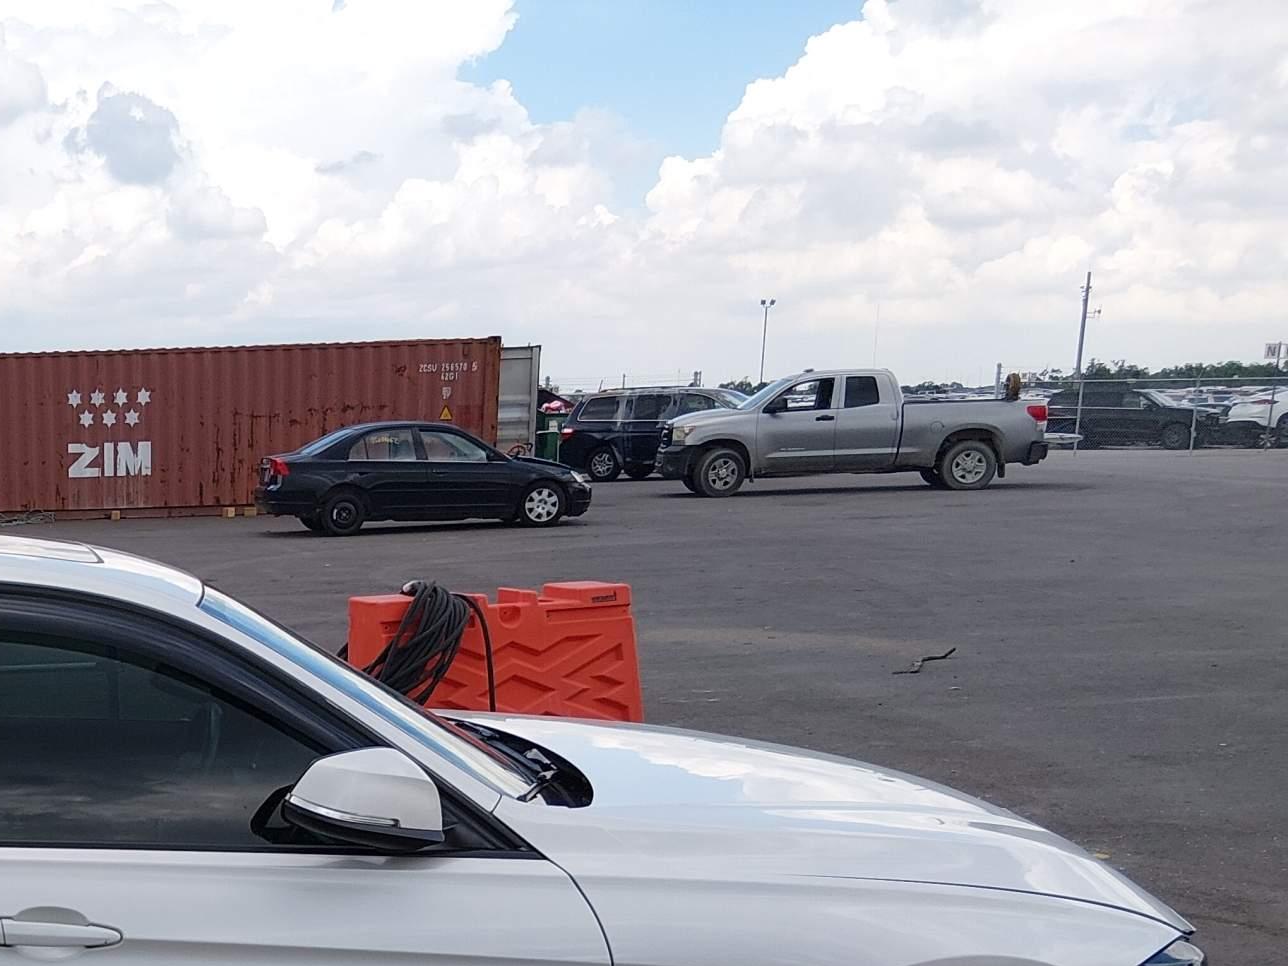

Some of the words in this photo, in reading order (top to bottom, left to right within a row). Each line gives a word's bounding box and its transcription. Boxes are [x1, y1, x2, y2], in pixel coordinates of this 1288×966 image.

[418, 363, 437, 373] ZCSU
[441, 362, 468, 372] 256570
[472, 361, 478, 372] 5
[67, 441, 152, 478] ZIM
